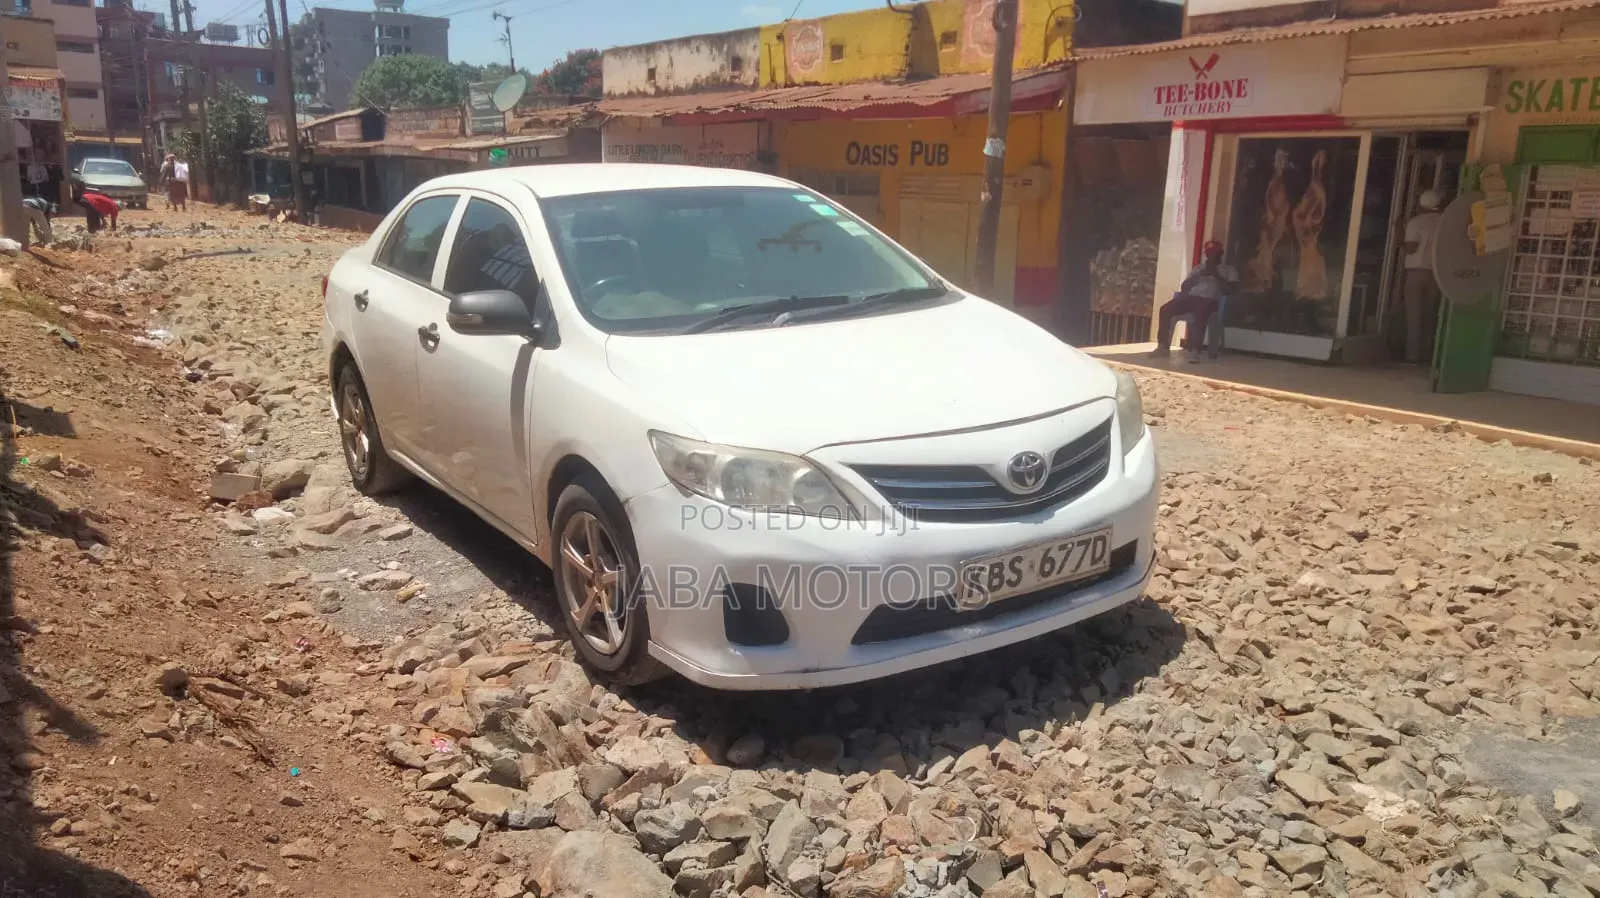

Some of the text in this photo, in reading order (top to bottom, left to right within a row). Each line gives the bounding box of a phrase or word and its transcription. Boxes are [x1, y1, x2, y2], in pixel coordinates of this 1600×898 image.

[1154, 78, 1248, 104] TEE-BONE
[1505, 76, 1600, 114] SKATE
[1163, 100, 1233, 117] BUTCHERY
[846, 140, 950, 166] OASIS PUB
[967, 535, 1107, 598] KBS 677D
